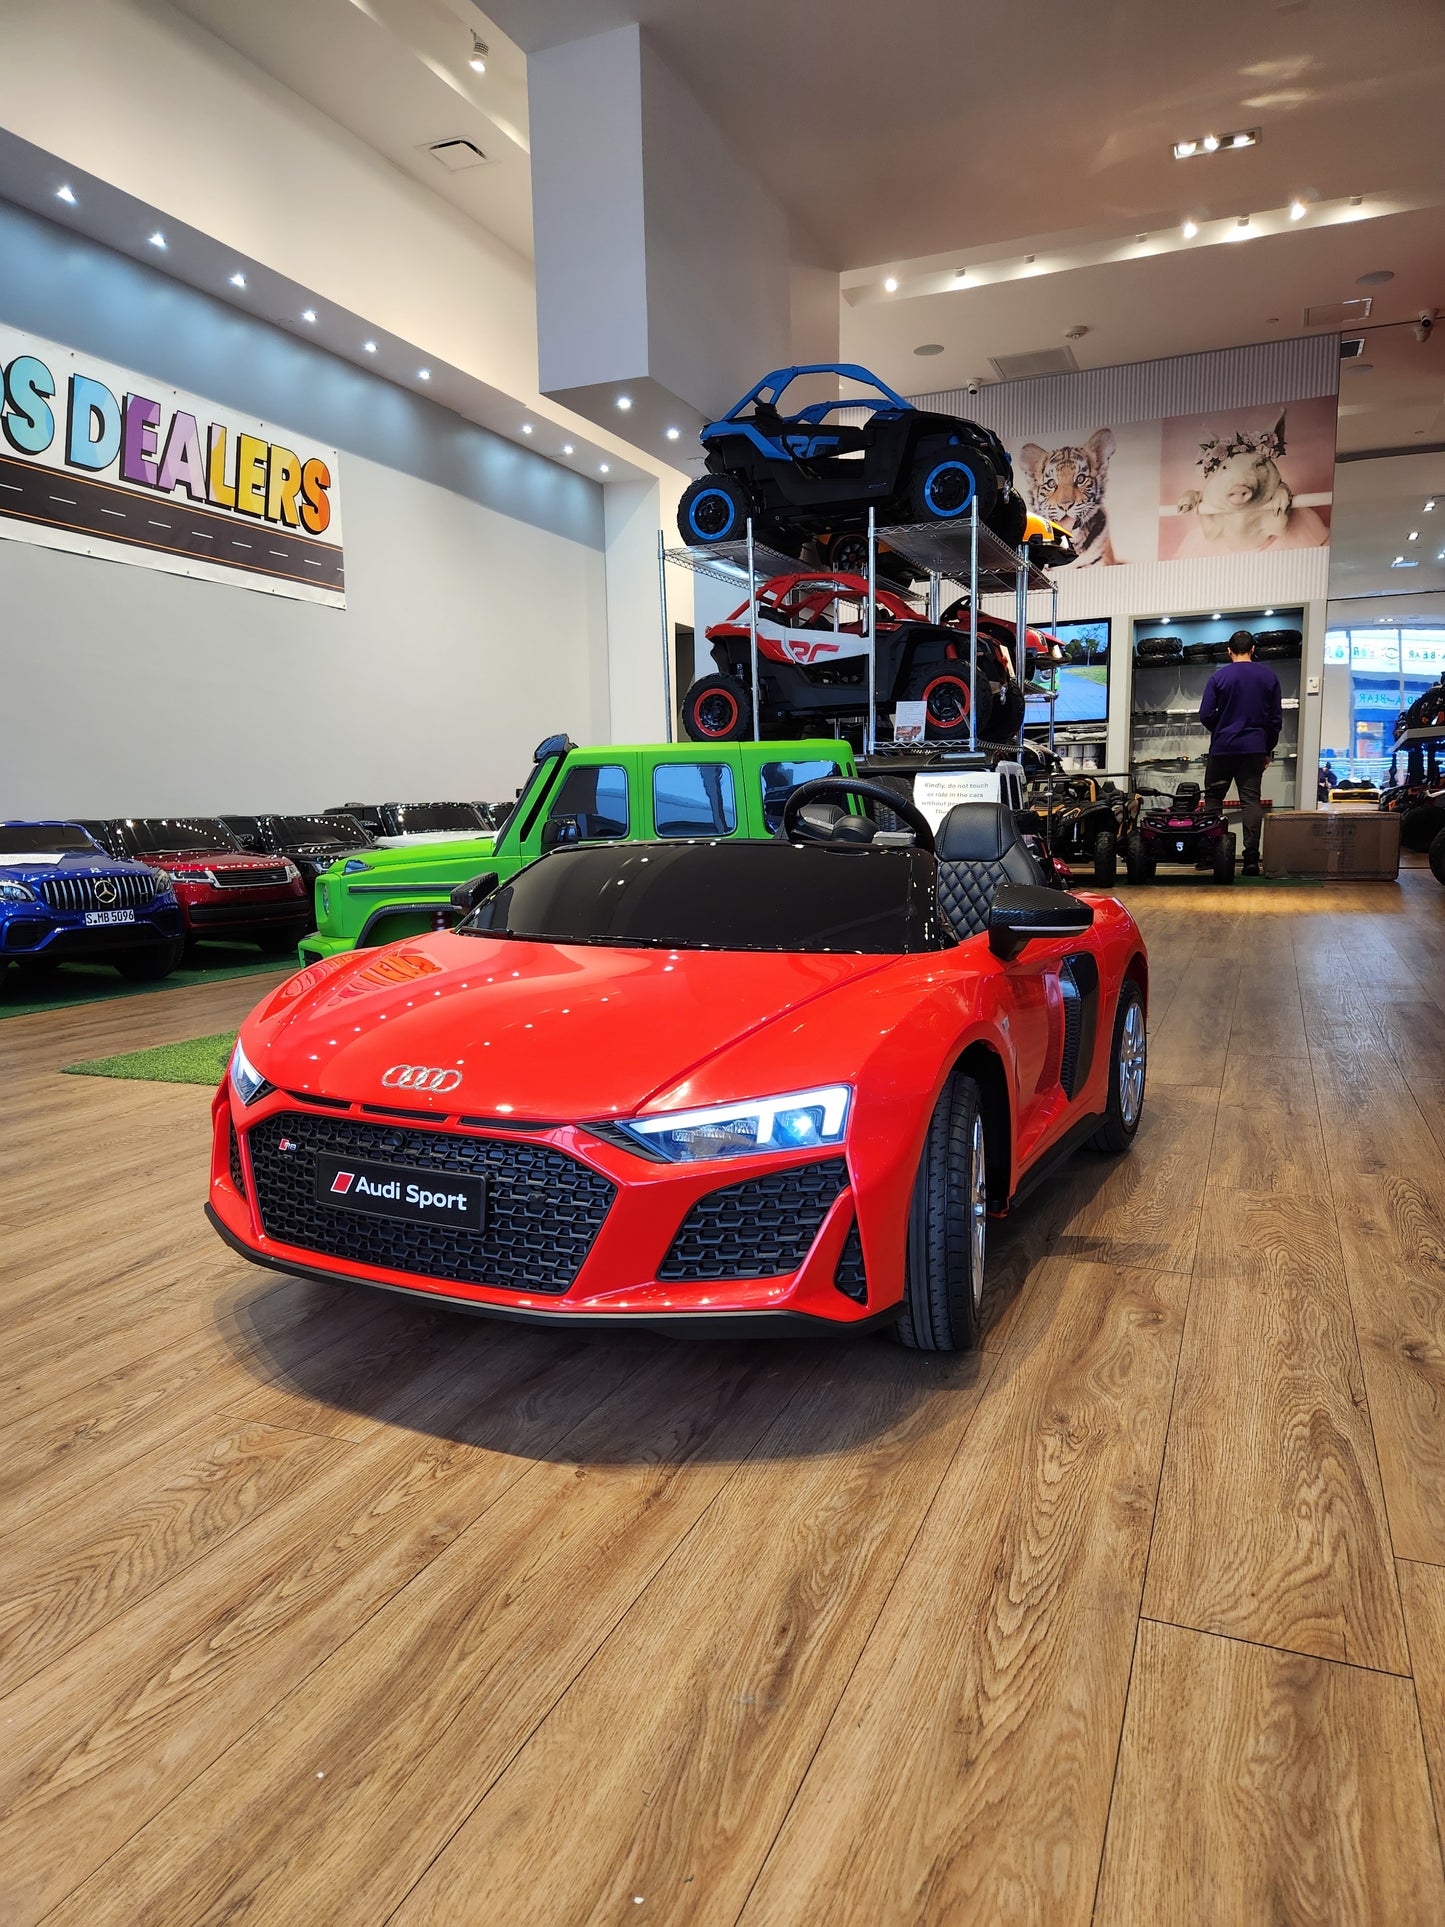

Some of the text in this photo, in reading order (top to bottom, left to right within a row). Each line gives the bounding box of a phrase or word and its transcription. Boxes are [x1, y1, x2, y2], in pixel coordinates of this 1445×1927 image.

[0, 355, 331, 535] S DEALERS
[111, 910, 134, 922] 5096
[355, 1176, 467, 1210] Audi Sport
